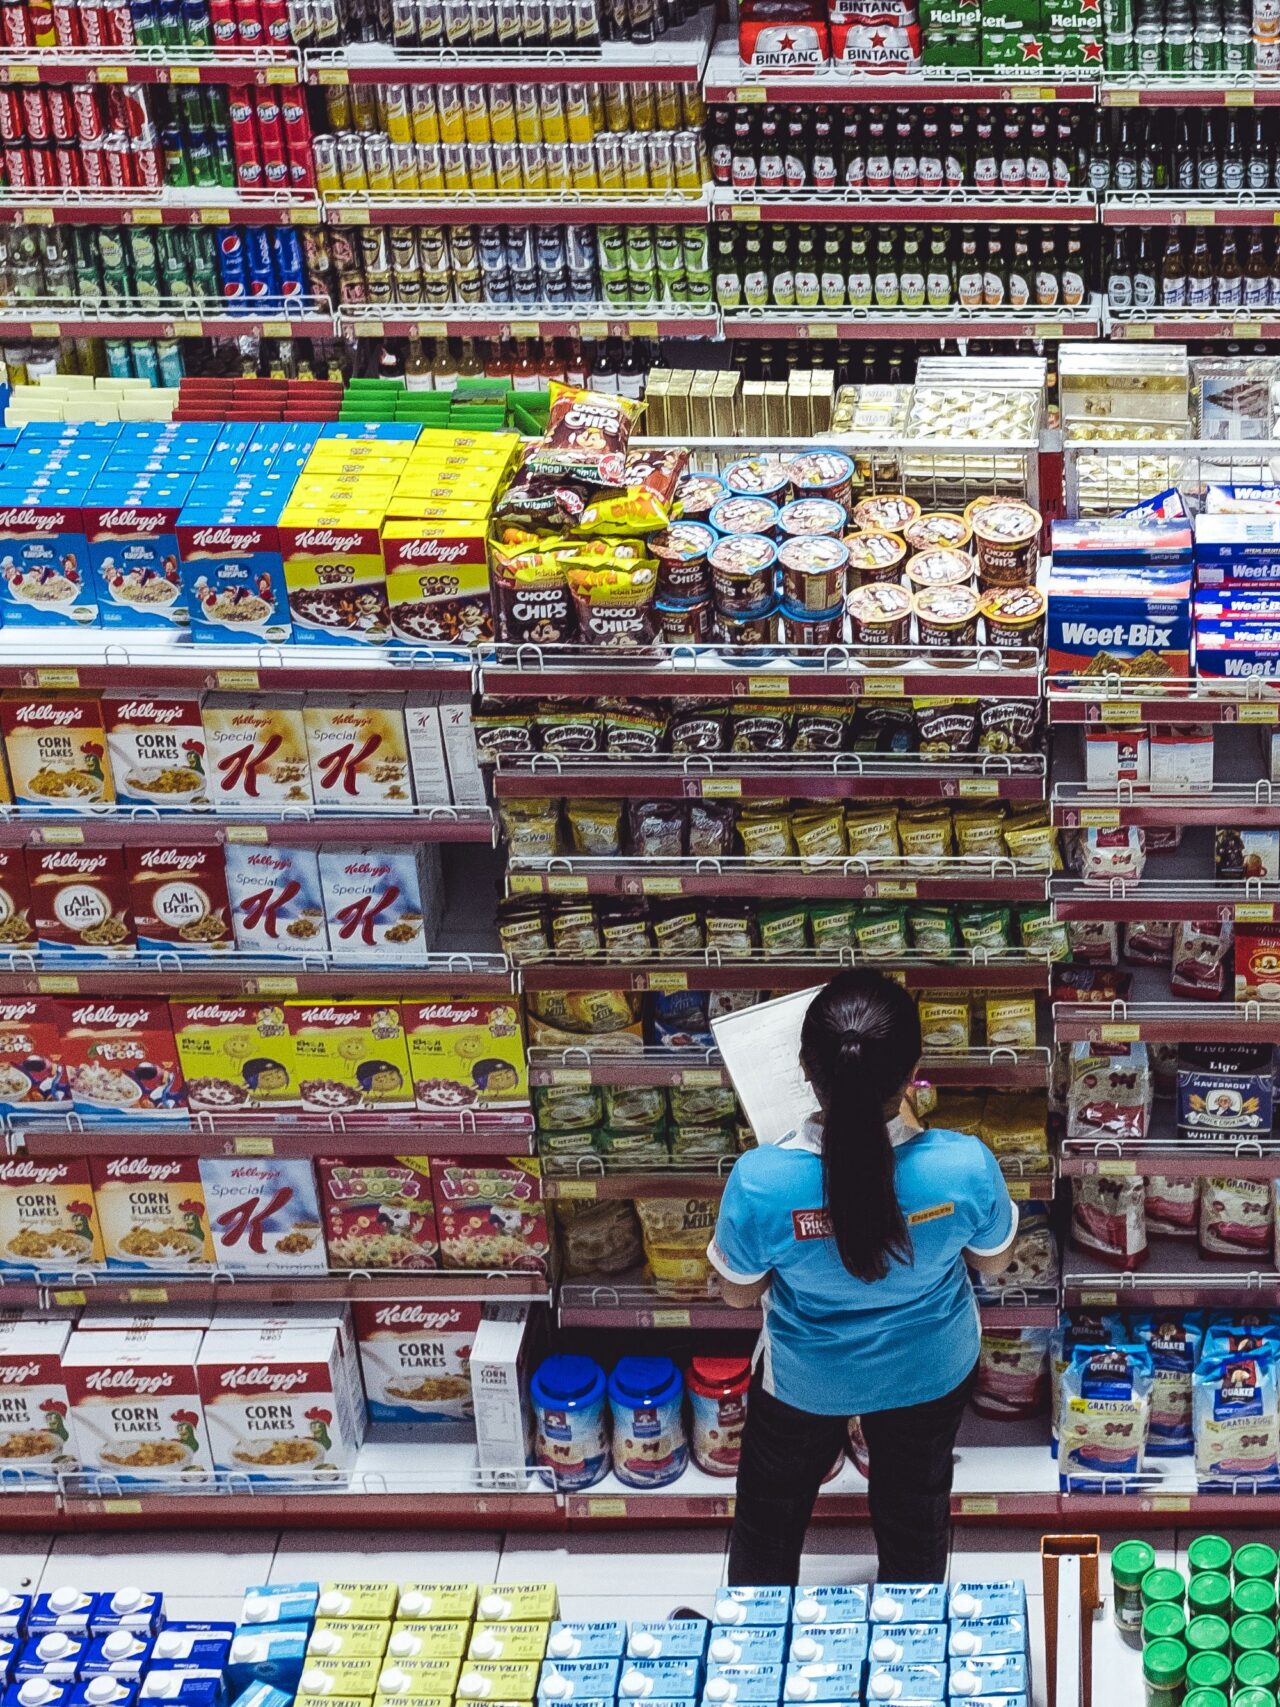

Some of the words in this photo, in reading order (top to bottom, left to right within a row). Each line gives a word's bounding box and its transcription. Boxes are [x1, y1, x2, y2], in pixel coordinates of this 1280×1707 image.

[839, 2, 901, 13] BINTANG
[756, 50, 819, 66] BINTANG
[848, 49, 909, 60] BINTANG
[573, 404, 618, 419] CHOCO
[565, 412, 619, 434] CHIPS
[99, 508, 166, 531] Kellogg's
[192, 528, 261, 549] Kellogg's
[295, 529, 363, 551] Kellogg's
[399, 539, 469, 562] Kellogg's
[671, 566, 700, 575] CHOCO
[517, 590, 562, 601] CHOCO
[512, 604, 567, 620] CHIPS
[592, 608, 636, 618] CHOCO
[589, 618, 643, 634] CHIPS
[1062, 623, 1172, 646] Weet-Bix
[16, 704, 83, 725] Kellogg's
[117, 702, 183, 723] Kellogg's
[136, 735, 176, 748] CORN
[213, 730, 256, 742] Special
[314, 730, 357, 741] Special
[38, 737, 71, 748] CORN
[39, 748, 73, 758] FLAKES
[138, 748, 179, 759] FLAKES
[218, 734, 283, 797] K
[318, 734, 382, 796] K
[905, 832, 942, 841] ENERGEN
[42, 852, 107, 871] Kellogg's
[141, 849, 206, 868] Kellogg's
[236, 874, 278, 887] Special
[332, 885, 376, 895] Special
[70, 896, 94, 906] All-
[169, 893, 193, 903] All-
[65, 905, 100, 917] Bran
[163, 901, 199, 913] Bran
[240, 880, 300, 938] K
[336, 886, 400, 946] K
[554, 914, 591, 927] ENERGEN
[606, 924, 643, 936] ENERGEN
[658, 914, 694, 933] ENERGEN
[708, 921, 745, 929] ENERGEN
[861, 923, 898, 937] ENERGEN
[72, 1005, 150, 1028] Kellogg's
[186, 1006, 245, 1021] Kellogg's
[925, 1007, 964, 1017] ENERGEN
[990, 1005, 1031, 1017] ENERGEN
[1210, 1061, 1240, 1071] Ligo
[1194, 1081, 1251, 1090] HAVERMOUT
[107, 1157, 181, 1182] Kellogg's
[211, 1184, 264, 1196] Special
[1226, 1179, 1257, 1193] GRATIS
[16, 1195, 56, 1207] CORN
[18, 1207, 59, 1217] FLAKES
[216, 1185, 293, 1254] K
[375, 1304, 462, 1328] Kellogg's
[399, 1343, 445, 1357] CORN
[400, 1356, 447, 1368] FLAKES
[1090, 1363, 1125, 1373] QUAKER
[86, 1368, 174, 1393] Kellogg's
[221, 1366, 309, 1391] Kellogg's
[1222, 1388, 1254, 1398] QUAKER
[245, 1405, 292, 1419] CORN
[1088, 1402, 1118, 1412] GRATIS
[112, 1408, 159, 1422] CORN
[114, 1420, 162, 1433] FLAKES
[248, 1418, 295, 1431] FLAKES
[1220, 1416, 1251, 1429] GRATIS
[414, 1583, 435, 1591] MILK
[439, 1583, 468, 1591] ULTRA
[517, 1584, 546, 1593] ULTRA
